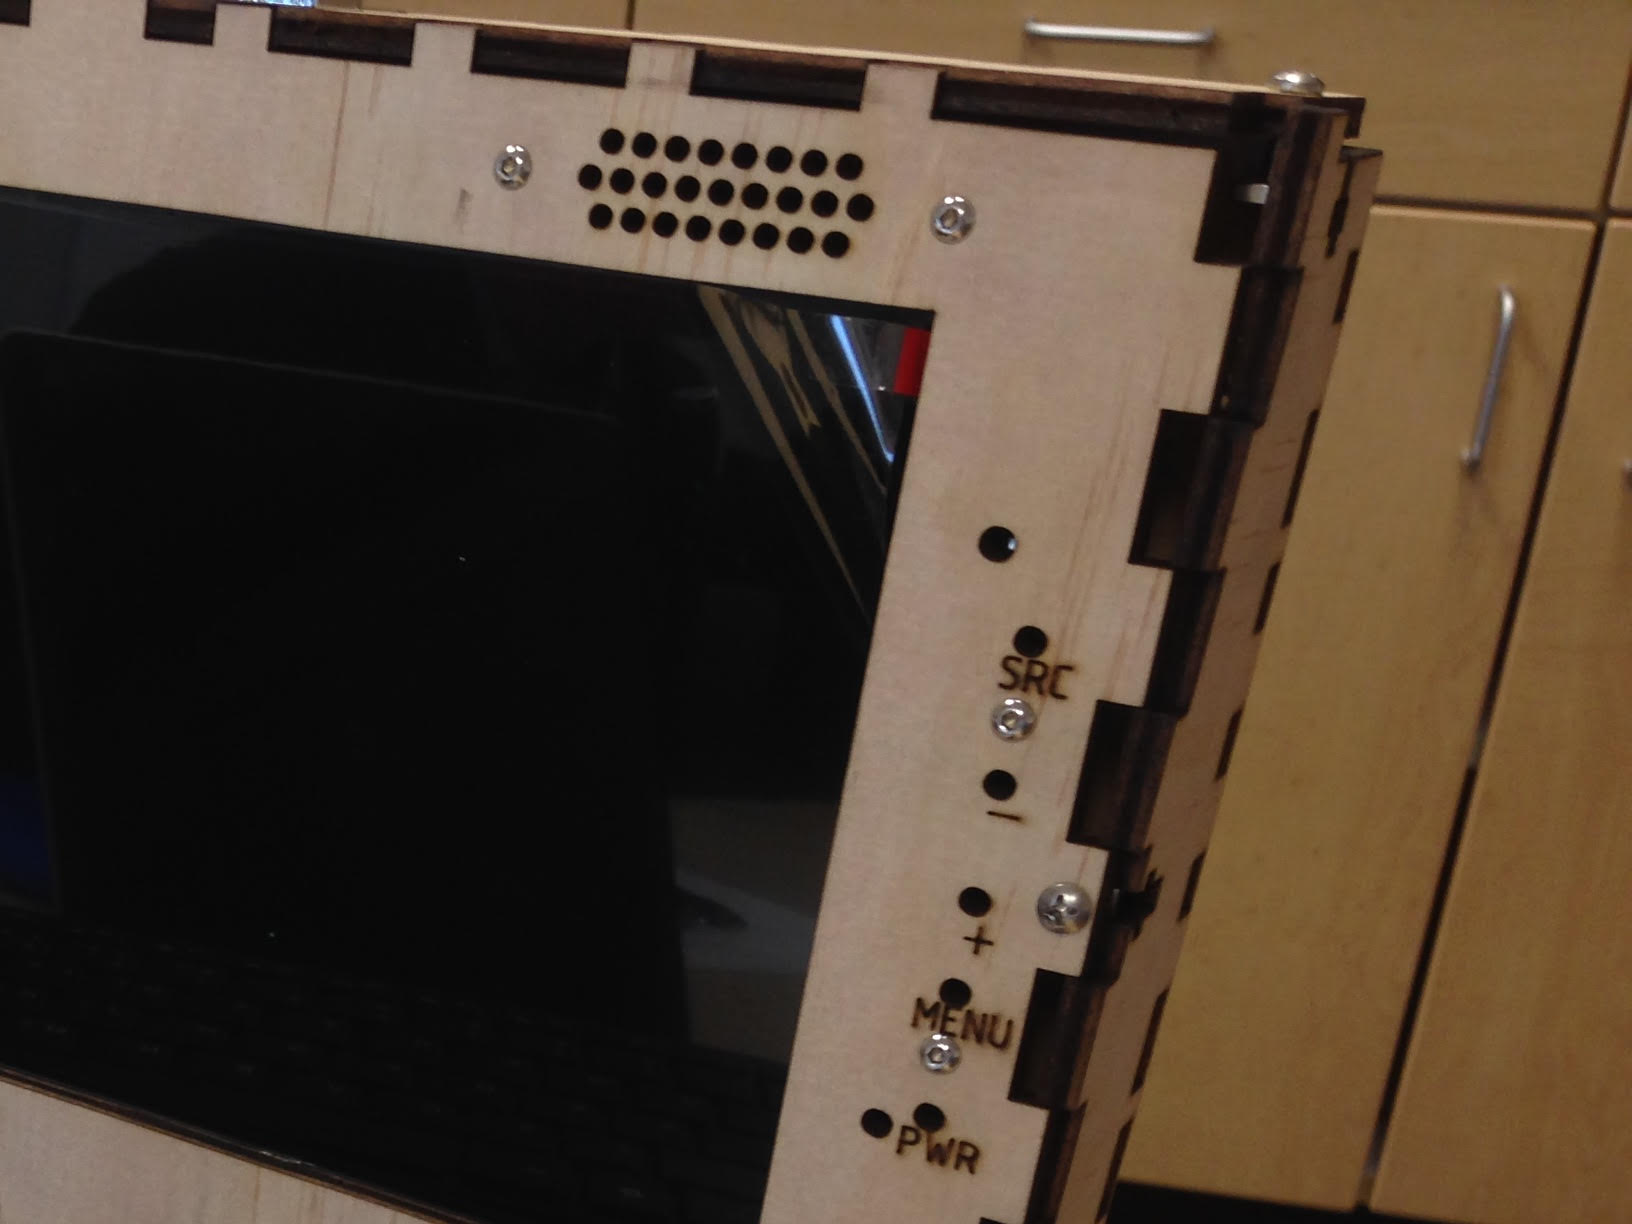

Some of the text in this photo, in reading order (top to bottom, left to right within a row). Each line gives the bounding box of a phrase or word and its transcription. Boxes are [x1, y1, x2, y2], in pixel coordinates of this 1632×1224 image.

[998, 654, 1075, 701] SRC
[962, 924, 996, 956] +
[911, 995, 1015, 1053] MENU
[895, 1124, 981, 1175] PWR
